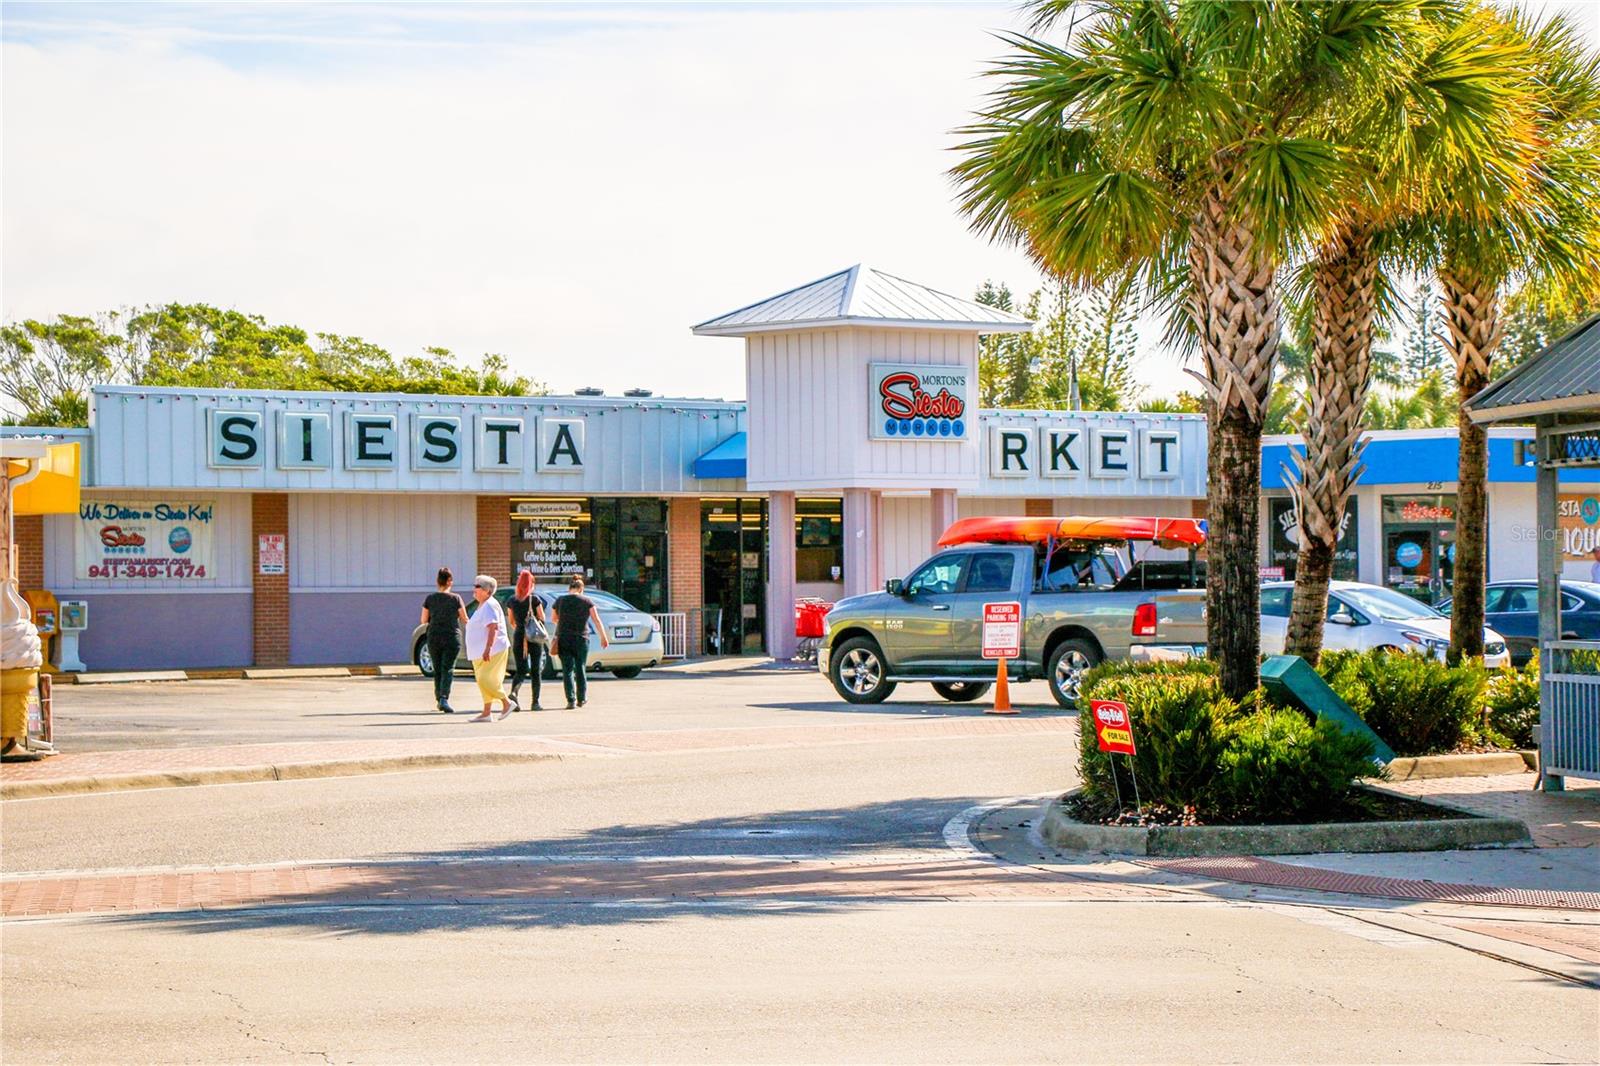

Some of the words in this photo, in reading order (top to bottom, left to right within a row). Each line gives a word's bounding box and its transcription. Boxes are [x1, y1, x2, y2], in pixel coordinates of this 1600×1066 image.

[921, 375, 966, 386] MORTON'S
[879, 372, 965, 420] Siesta
[886, 421, 963, 434] MARKET
[220, 416, 583, 465] SIESTA
[79, 503, 102, 520] We
[103, 504, 141, 520] Deliver
[154, 503, 187, 521] Siesta
[188, 504, 213, 523] Key!
[100, 525, 146, 547] Siesta
[88, 565, 206, 578] 941-349-1474
[986, 613, 1007, 622] PARKING
[1008, 613, 1018, 621] FOR
[1107, 732, 1119, 740] FOR
[1119, 733, 1130, 742] SALE
